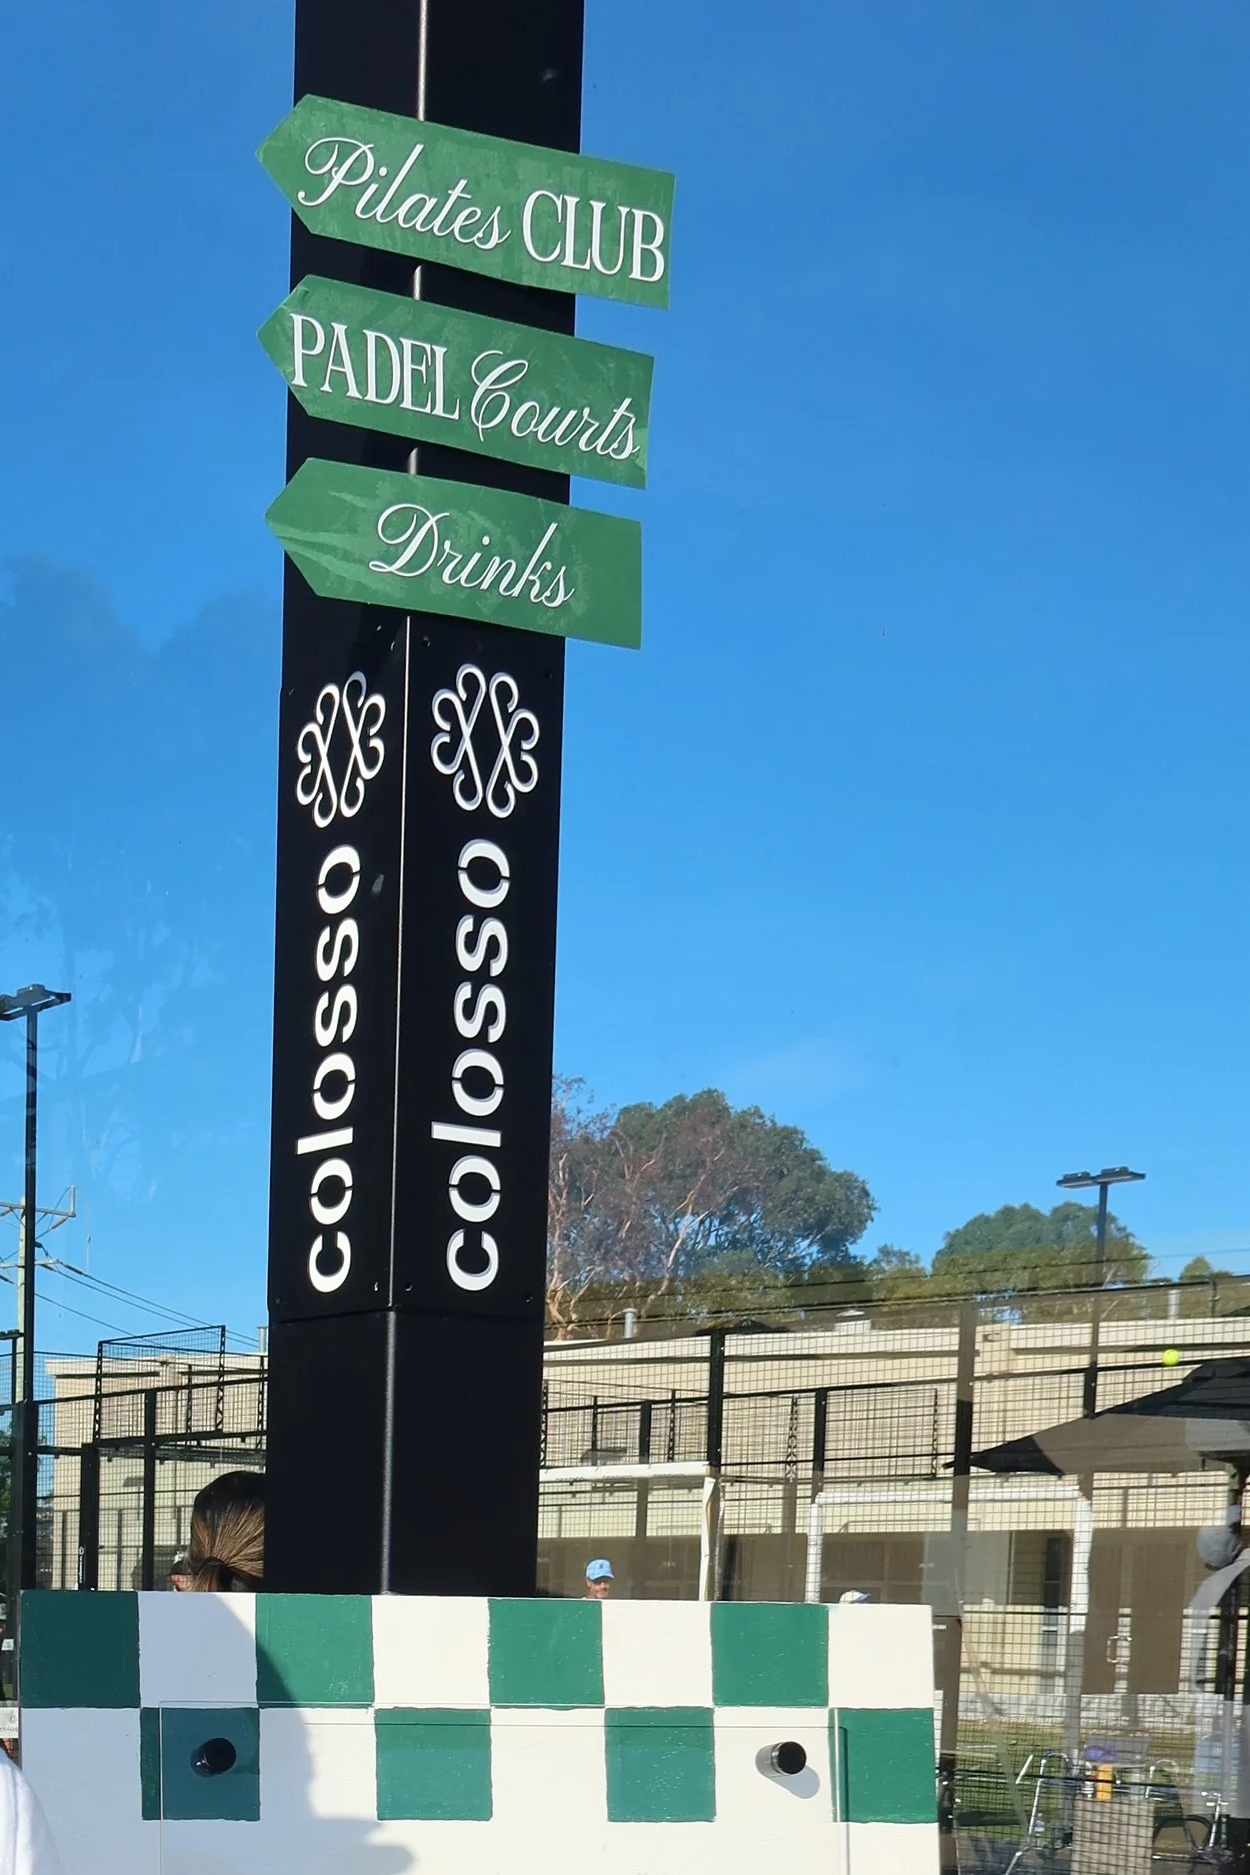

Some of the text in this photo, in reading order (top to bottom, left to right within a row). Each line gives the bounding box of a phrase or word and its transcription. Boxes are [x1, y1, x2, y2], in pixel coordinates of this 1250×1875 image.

[298, 136, 665, 283] Pilates CLUB
[290, 313, 641, 461] PADEL Courts
[368, 502, 575, 607] Drinks
[297, 844, 360, 1292] colosso
[431, 838, 510, 1291] colosso
